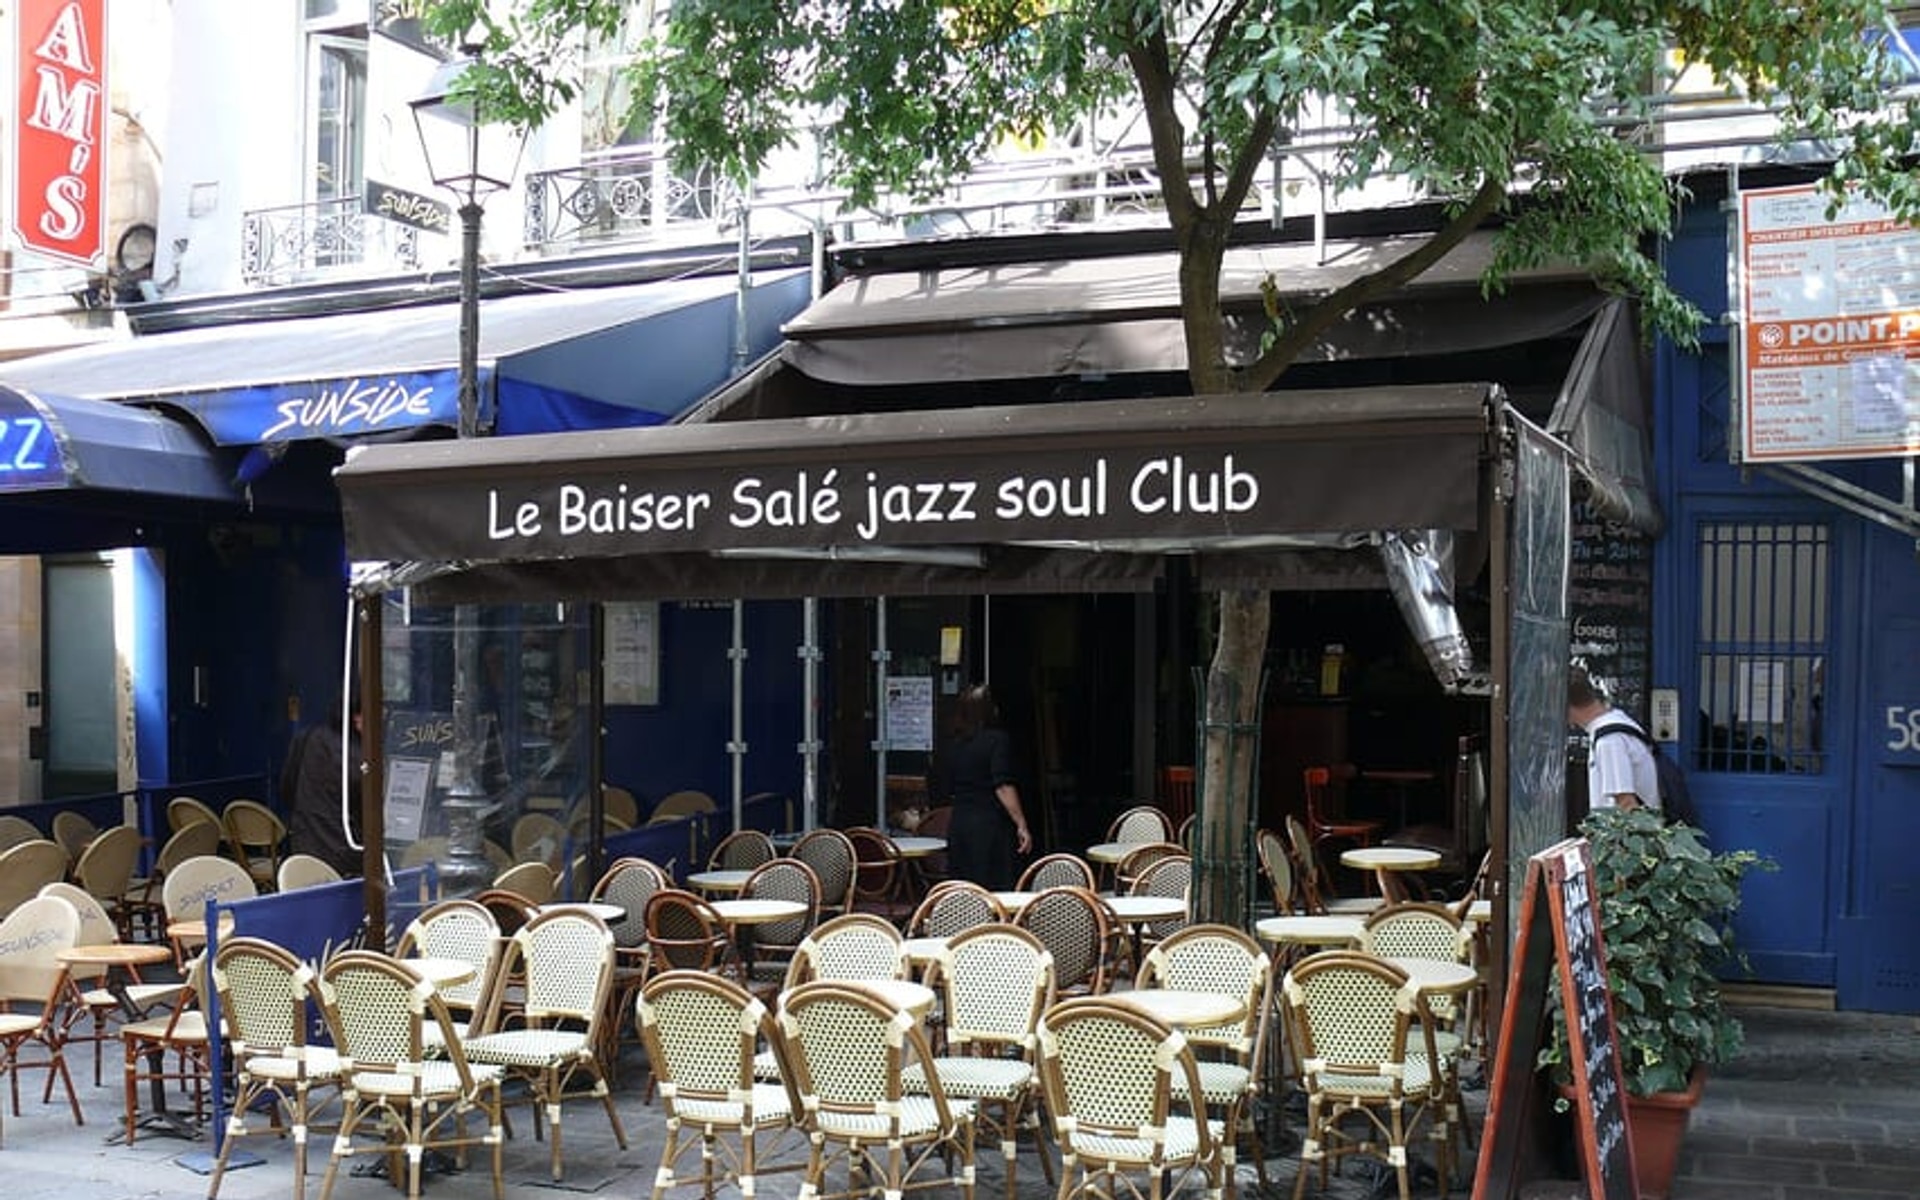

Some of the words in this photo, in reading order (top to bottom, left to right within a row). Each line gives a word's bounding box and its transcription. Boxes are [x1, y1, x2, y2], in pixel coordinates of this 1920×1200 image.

[487, 489, 542, 540] Le
[559, 483, 711, 536] Baiser
[729, 467, 842, 529] Salé
[856, 471, 978, 541] jazz
[995, 458, 1108, 518] soul
[1130, 454, 1260, 515] Club
